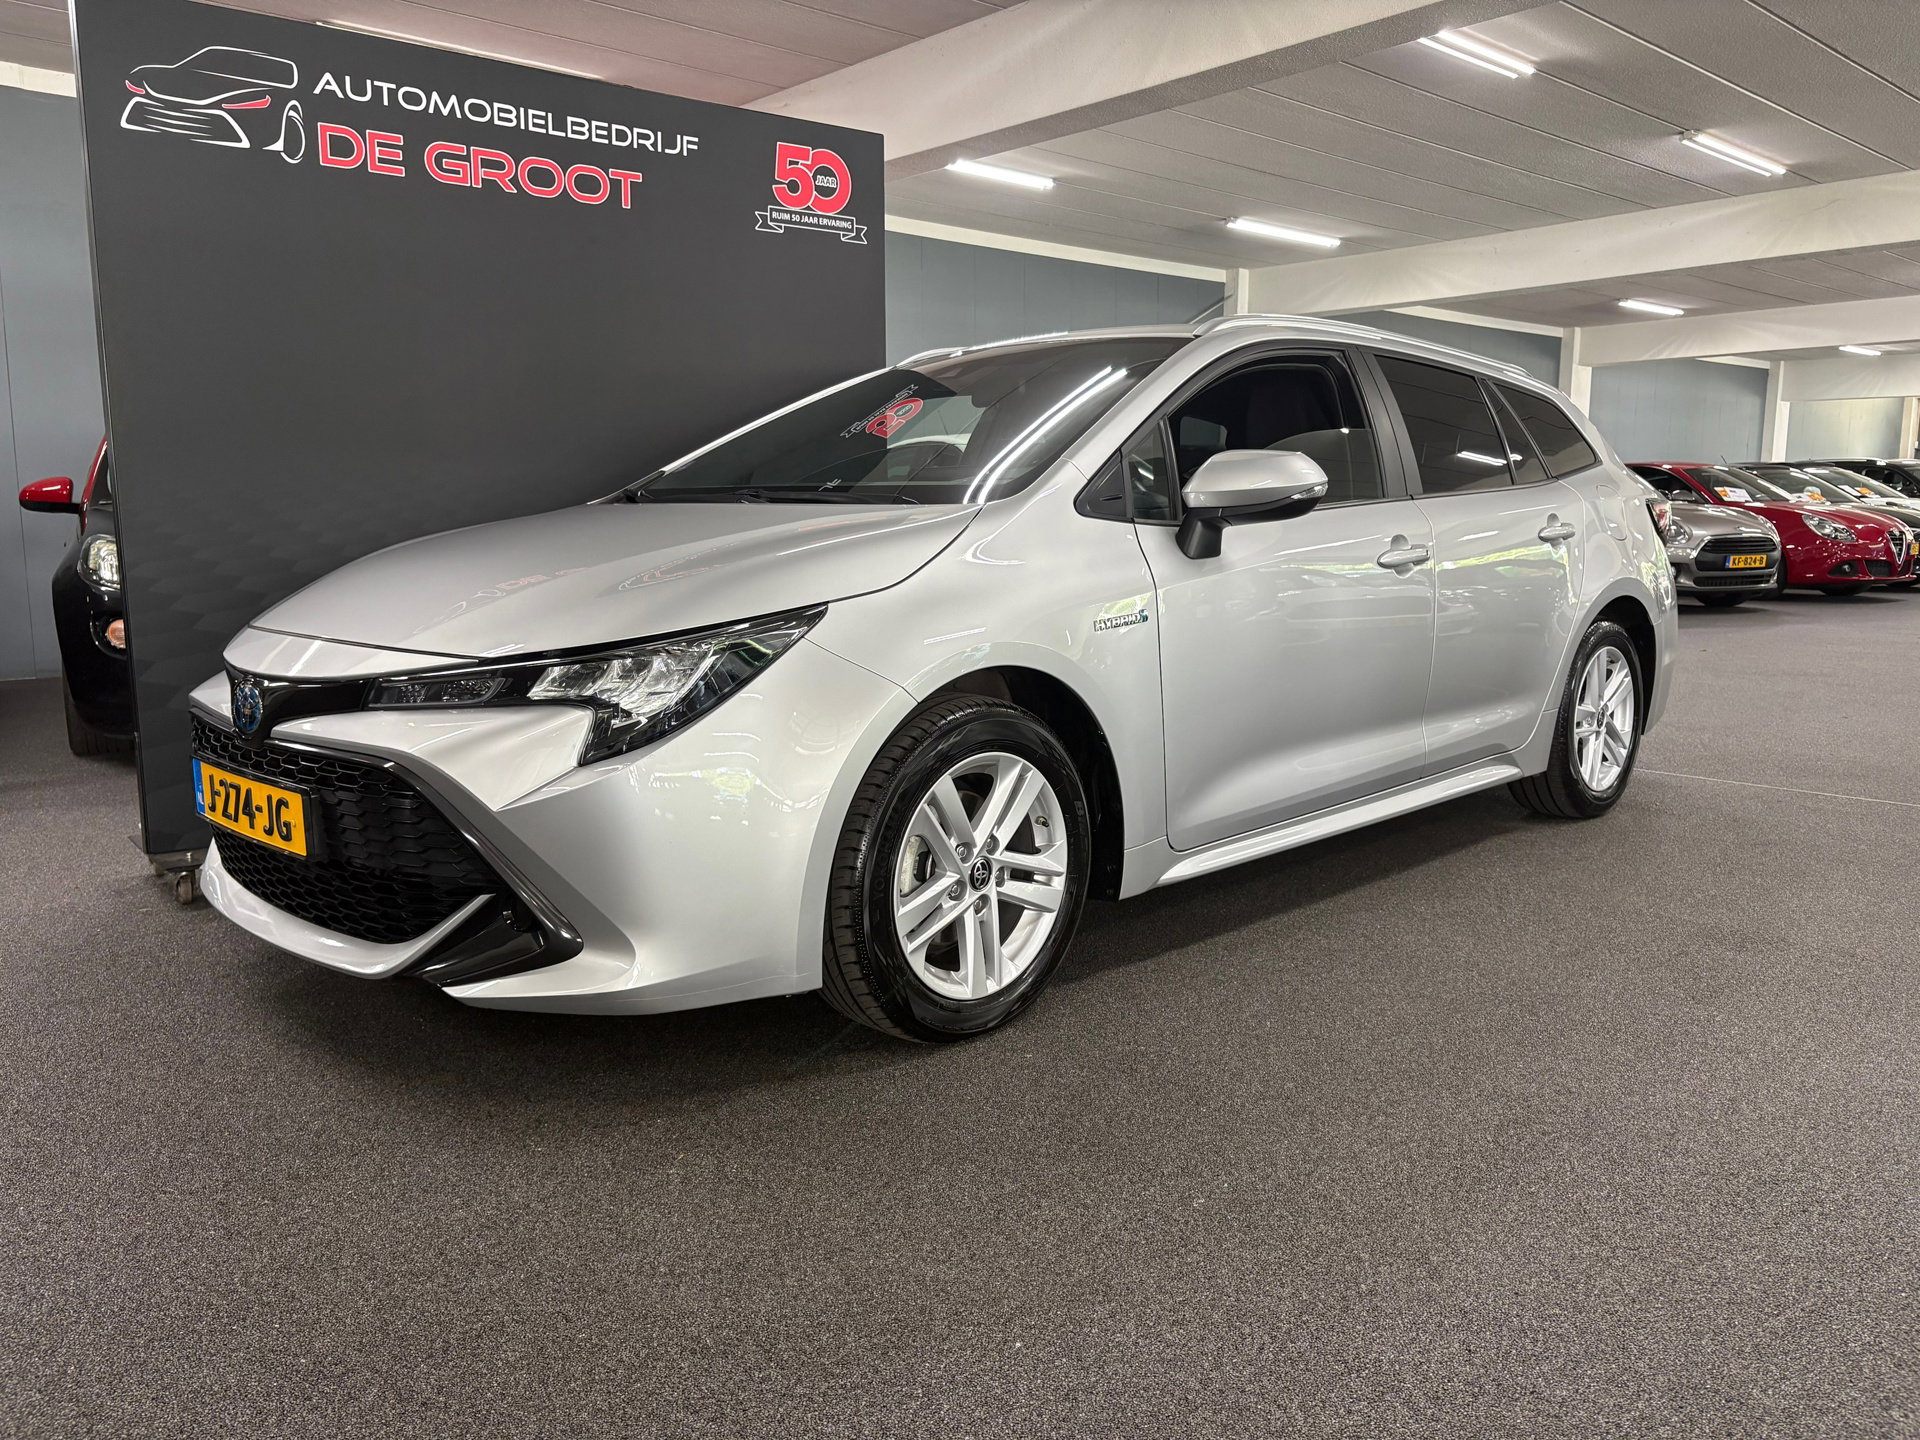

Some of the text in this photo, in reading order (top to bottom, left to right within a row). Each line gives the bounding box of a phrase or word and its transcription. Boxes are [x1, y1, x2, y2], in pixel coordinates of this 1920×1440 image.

[313, 72, 699, 156] AUTOMOBIELBEDRIJF
[317, 121, 643, 209] DE GROOT
[772, 141, 852, 215] 50
[815, 175, 837, 188] JAAR
[772, 211, 852, 229] RUIM 50 JAAR ERVARING
[1731, 556, 1764, 566] KF-824-B
[208, 773, 293, 842] J-274-JG
